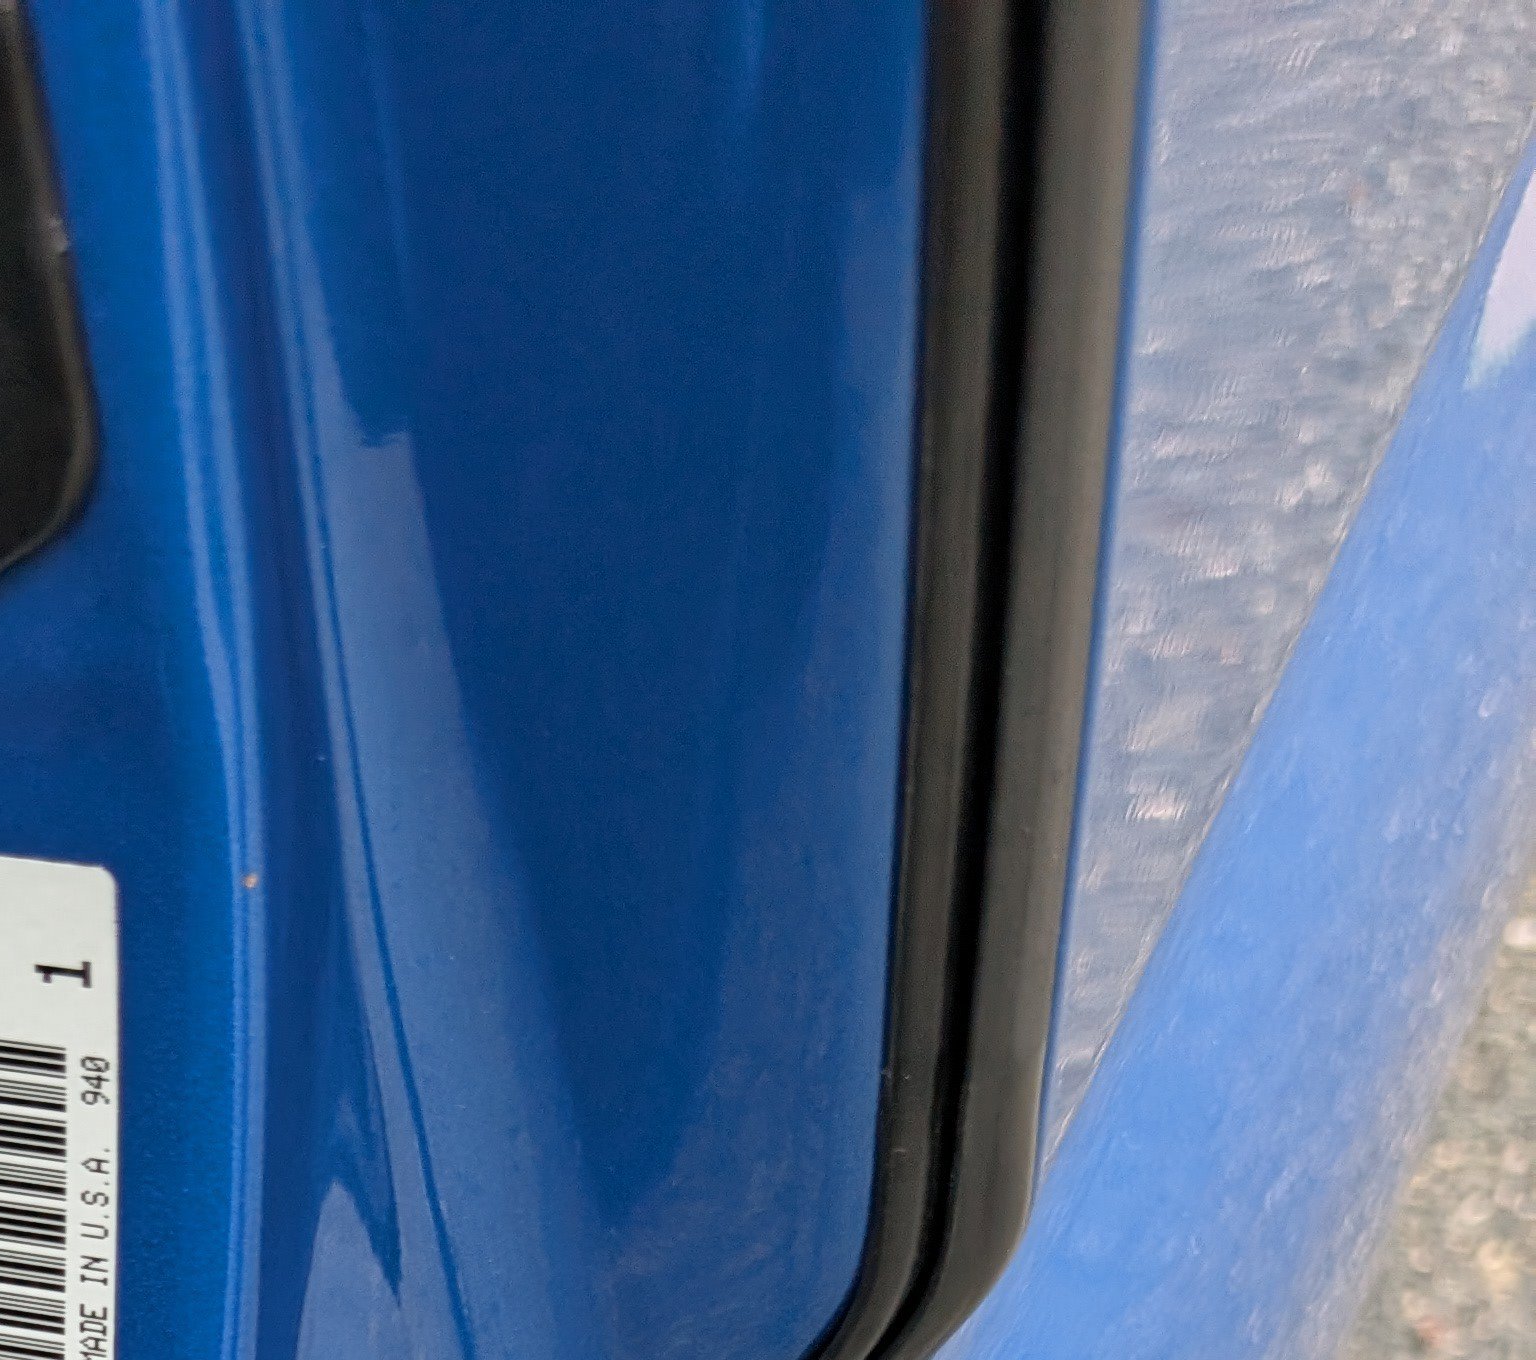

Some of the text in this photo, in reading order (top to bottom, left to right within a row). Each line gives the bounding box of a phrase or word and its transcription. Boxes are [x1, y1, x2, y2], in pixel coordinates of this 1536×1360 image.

[34, 960, 92, 989] 1
[80, 1055, 109, 1106] 940
[80, 1149, 110, 1240] U.S.A.
[79, 1255, 108, 1286] IN
